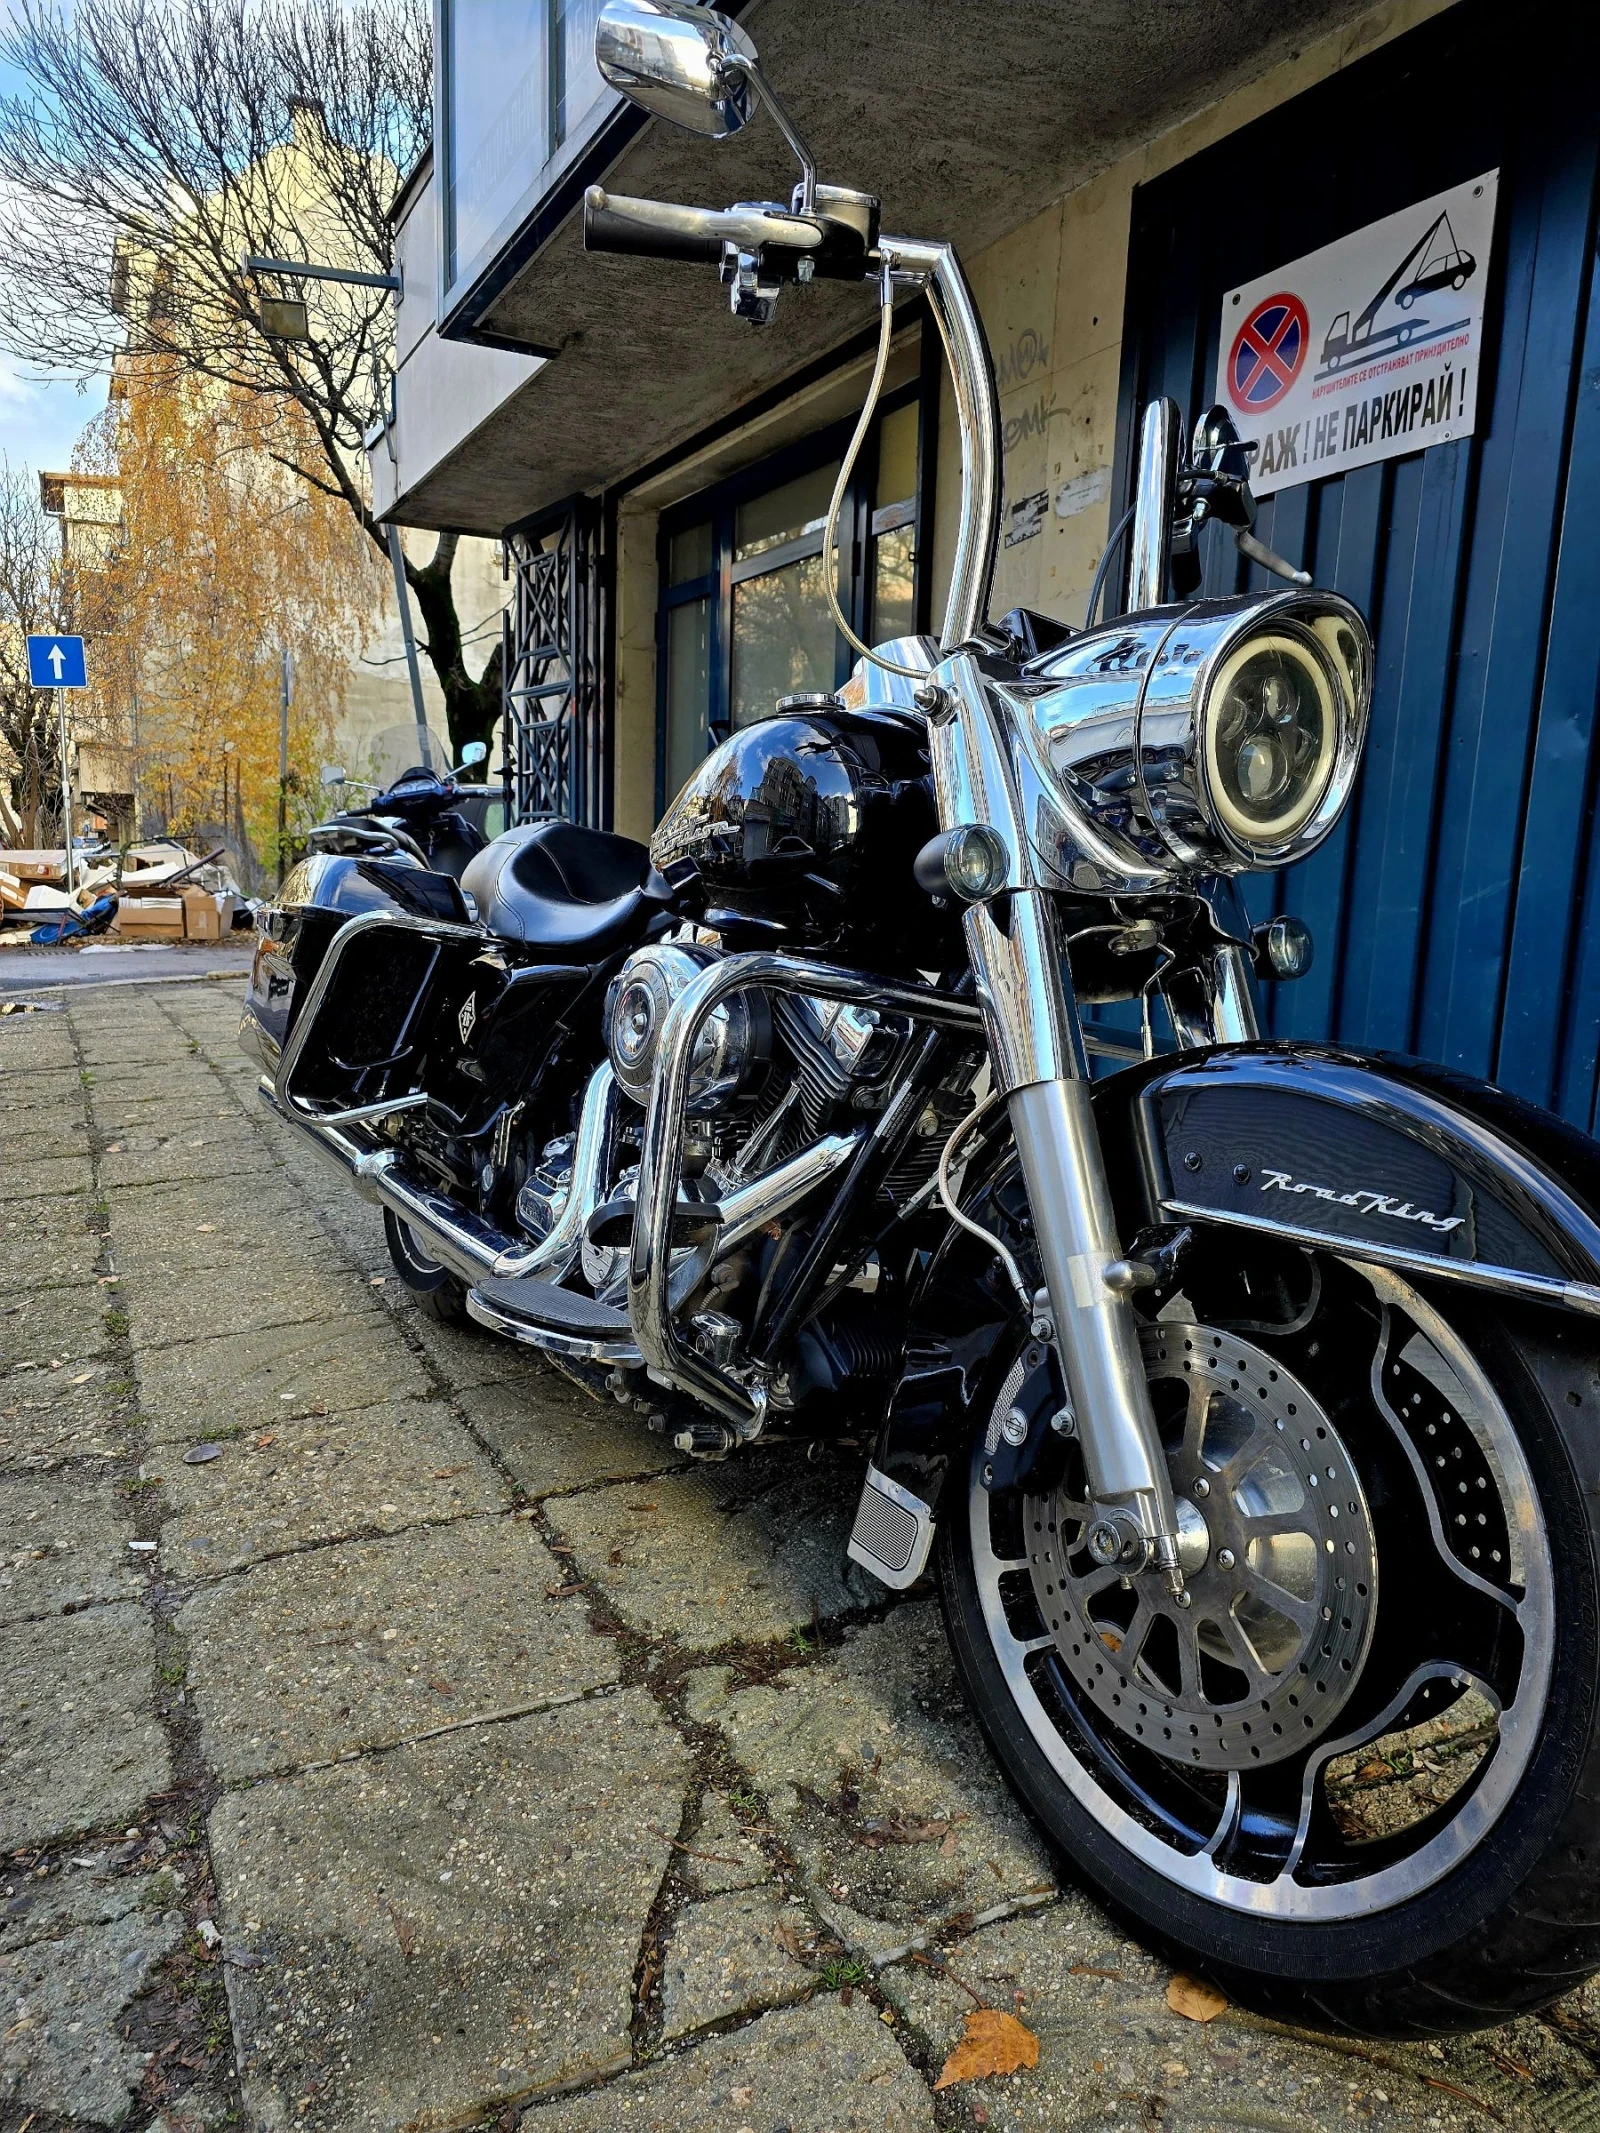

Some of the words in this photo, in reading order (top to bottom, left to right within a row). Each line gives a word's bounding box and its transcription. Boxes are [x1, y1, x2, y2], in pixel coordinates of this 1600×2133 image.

[1312, 373, 1358, 399] НАРУШИТЕЛИТЕ
[1358, 370, 1367, 381] СЕ
[1368, 353, 1414, 378] ОТСТРАНЯВАТ
[1414, 333, 1469, 363] ПРИНУДИТЕЛНО
[1313, 411, 1339, 463] НЕ
[1261, 1169, 1358, 1206] Road
[1358, 1190, 1466, 1232] King
